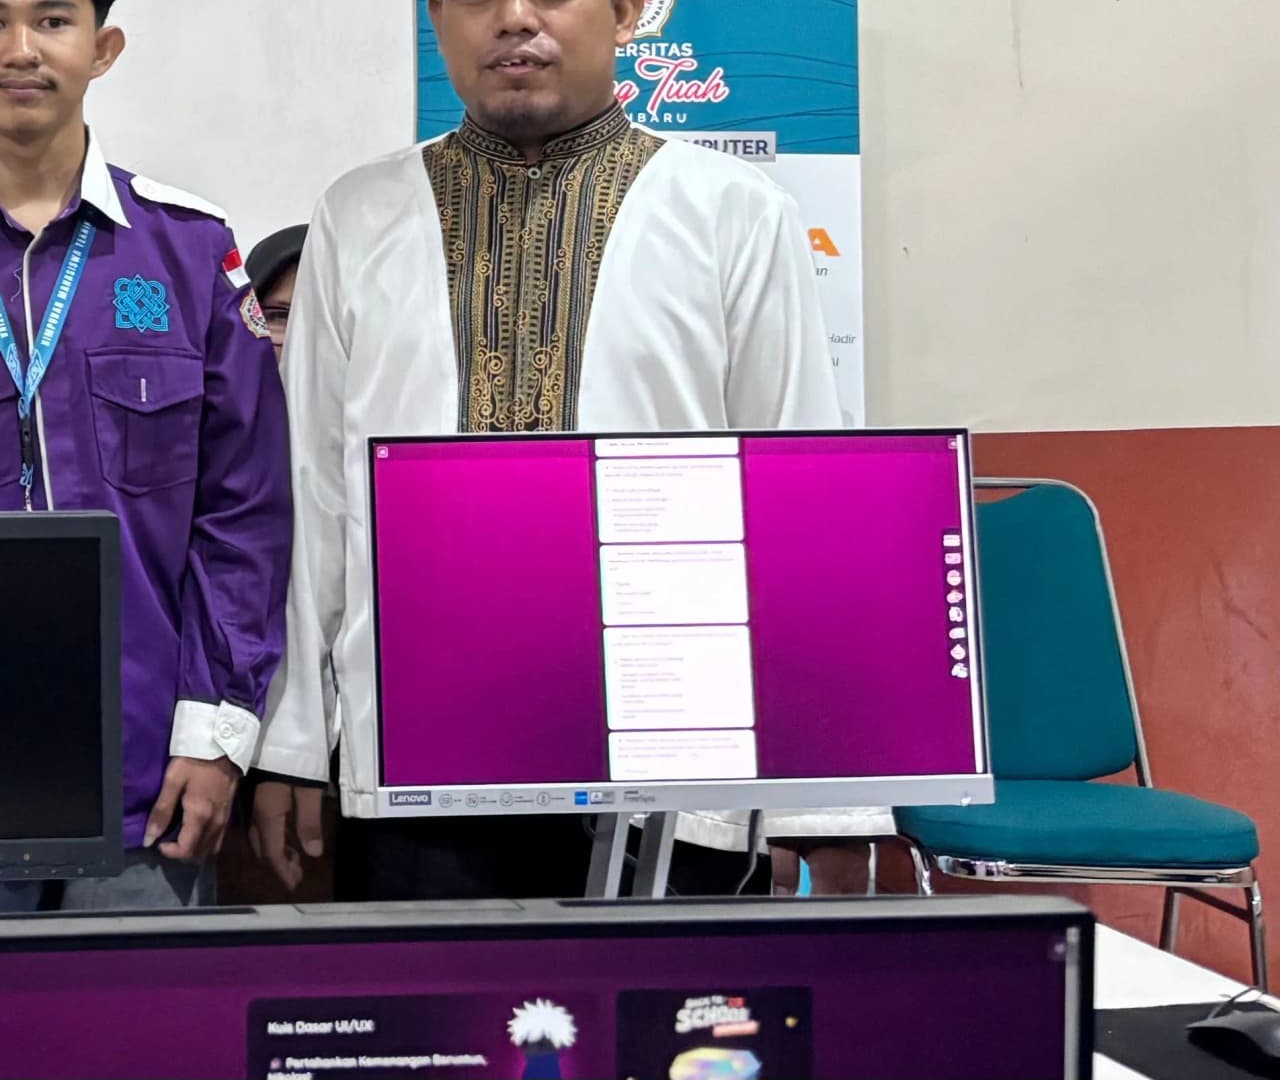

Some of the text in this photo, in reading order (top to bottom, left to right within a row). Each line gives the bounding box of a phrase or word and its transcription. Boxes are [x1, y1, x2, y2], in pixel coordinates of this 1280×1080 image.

[614, 42, 694, 57] ERSITAS
[636, 56, 730, 114] Tuah
[391, 793, 429, 804] Lenovo
[267, 1019, 375, 1035] Kuis Dasar UI/UX
